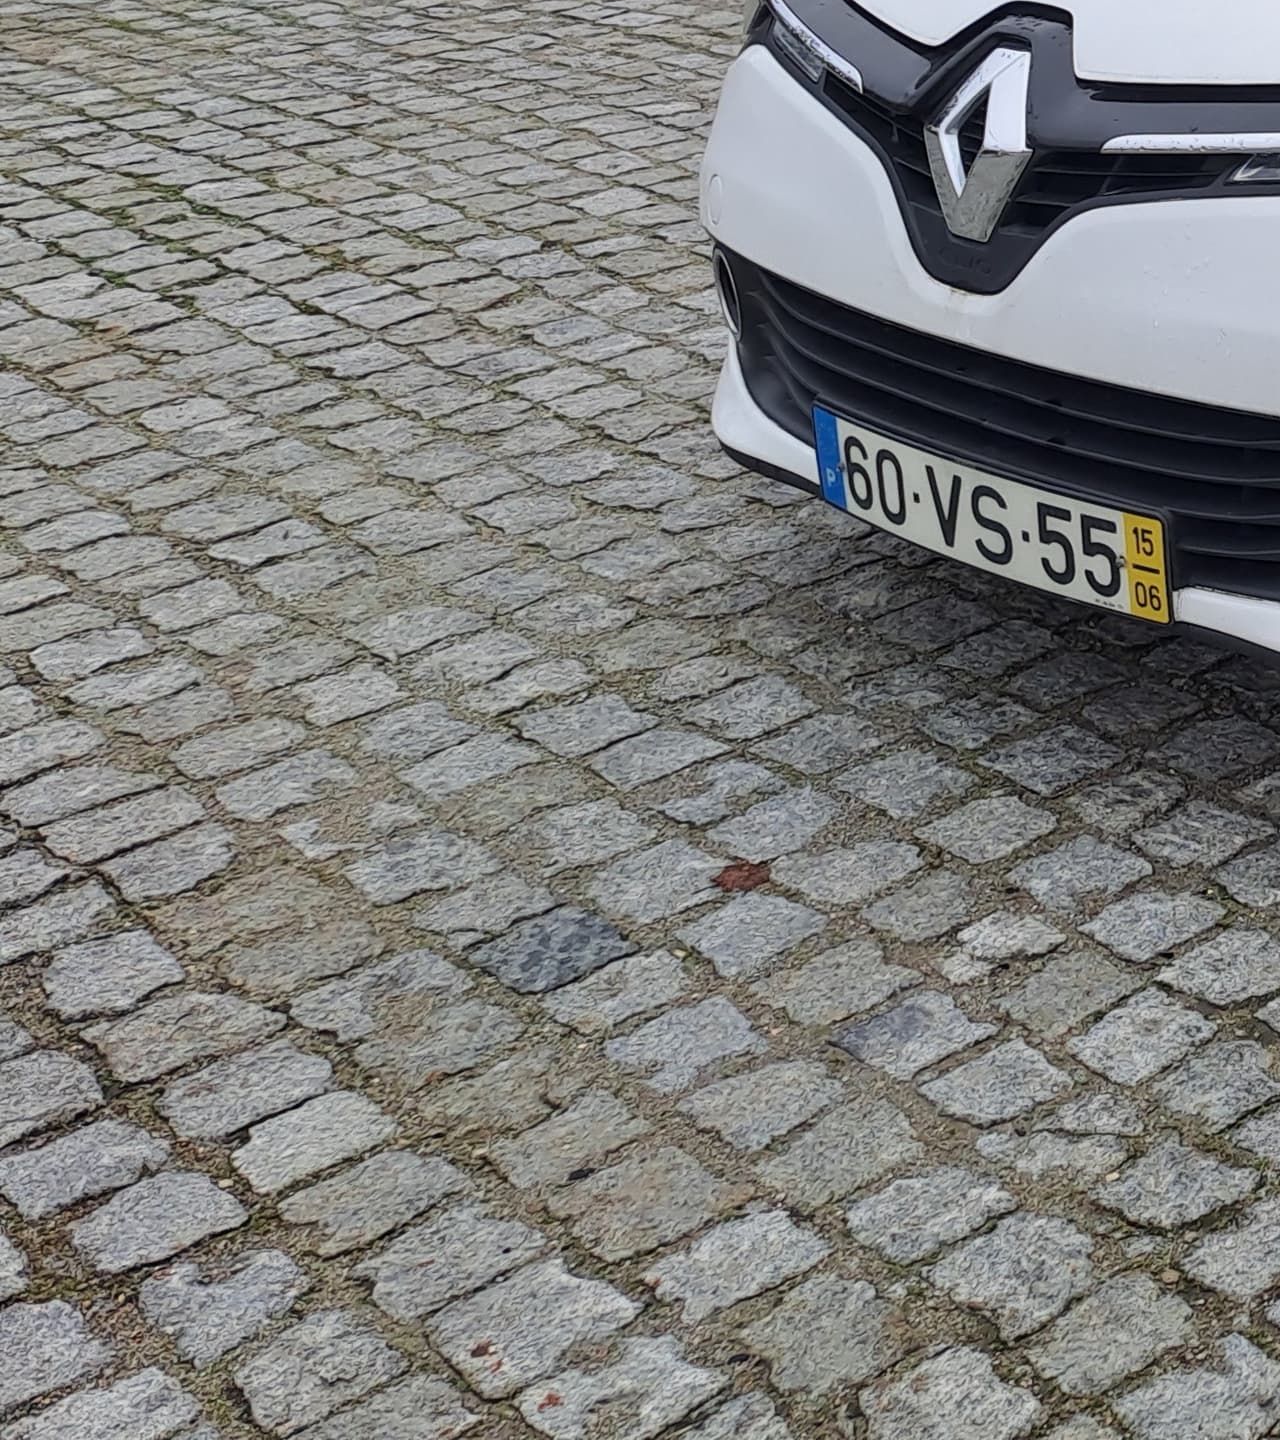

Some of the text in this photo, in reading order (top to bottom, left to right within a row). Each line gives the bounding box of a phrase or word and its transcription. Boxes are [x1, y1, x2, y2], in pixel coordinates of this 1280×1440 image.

[825, 467, 836, 486] P
[1132, 526, 1155, 557] 15
[1134, 581, 1162, 611] 06
